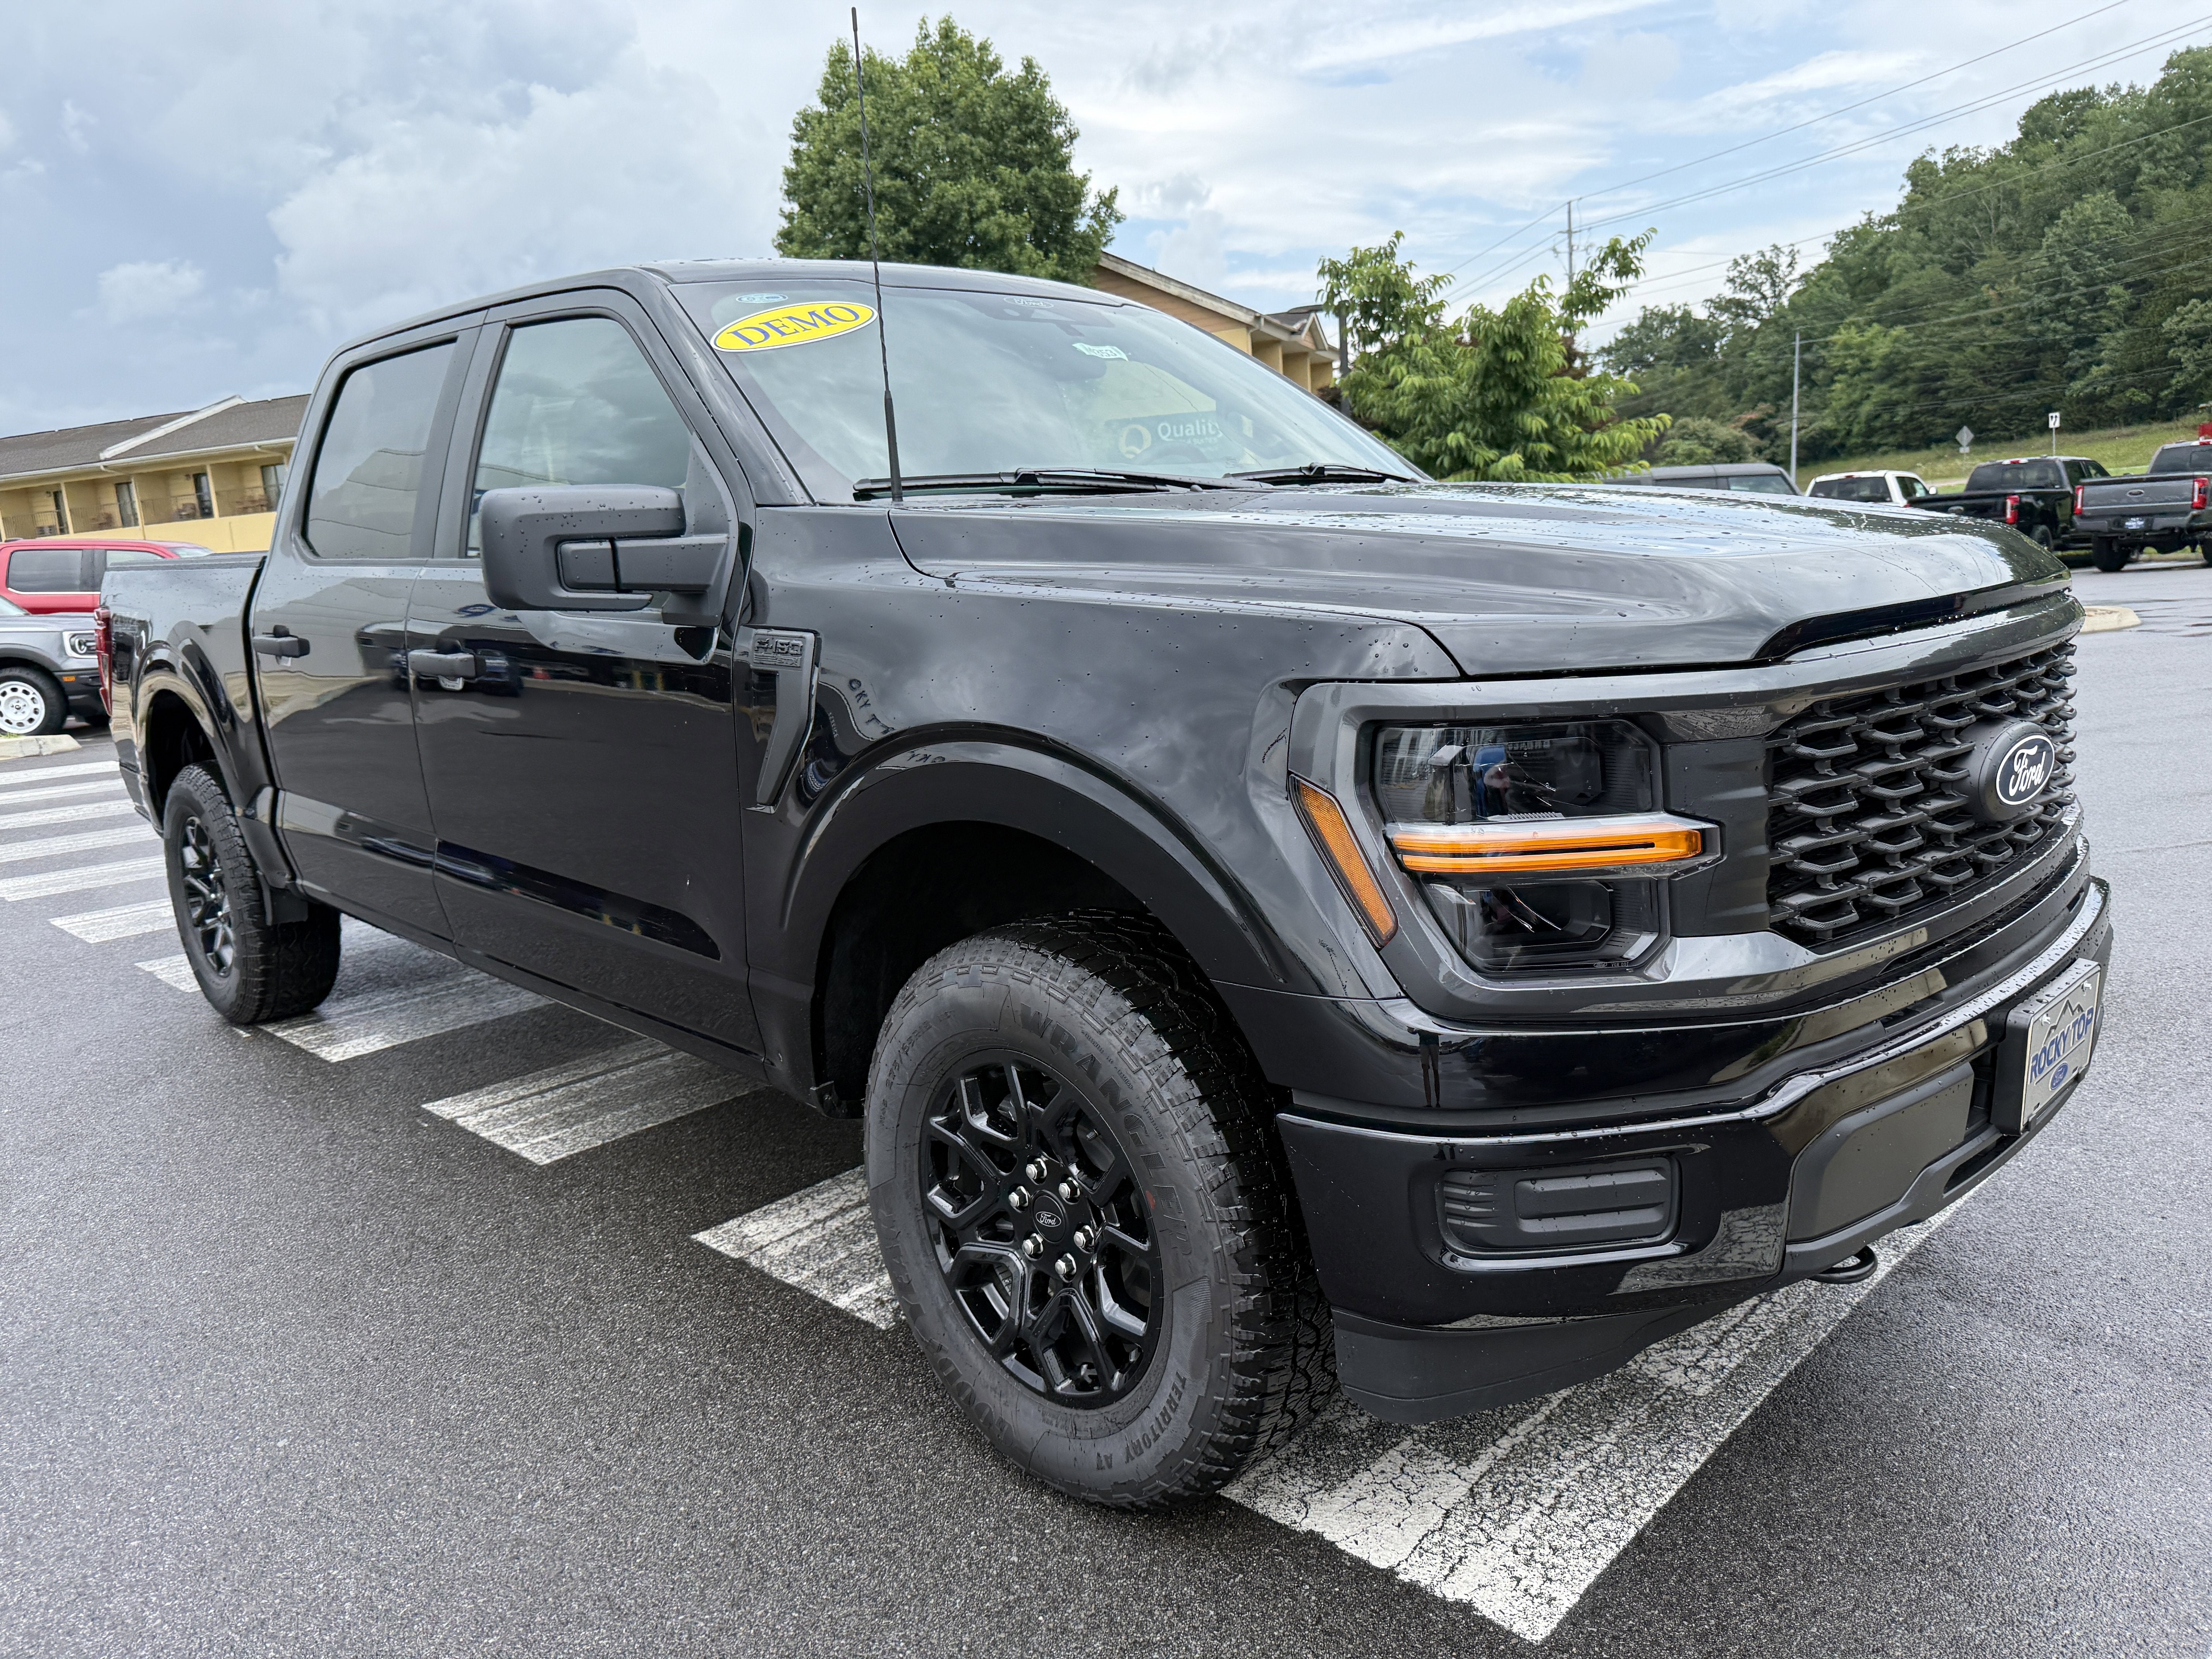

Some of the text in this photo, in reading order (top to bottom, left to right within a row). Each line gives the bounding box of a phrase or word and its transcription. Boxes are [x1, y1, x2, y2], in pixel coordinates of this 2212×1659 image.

[727, 306, 860, 346] DEMO
[1157, 418, 1224, 441] Quality
[2009, 745, 2046, 796] Ford
[2030, 1007, 2094, 1083] ROCKY TOP
[1020, 1002, 1192, 1254] WRANGLER
[1040, 1213, 1056, 1225] Ford
[1125, 1370, 1187, 1464] TERRITORY
[1096, 1451, 1113, 1470] AT
